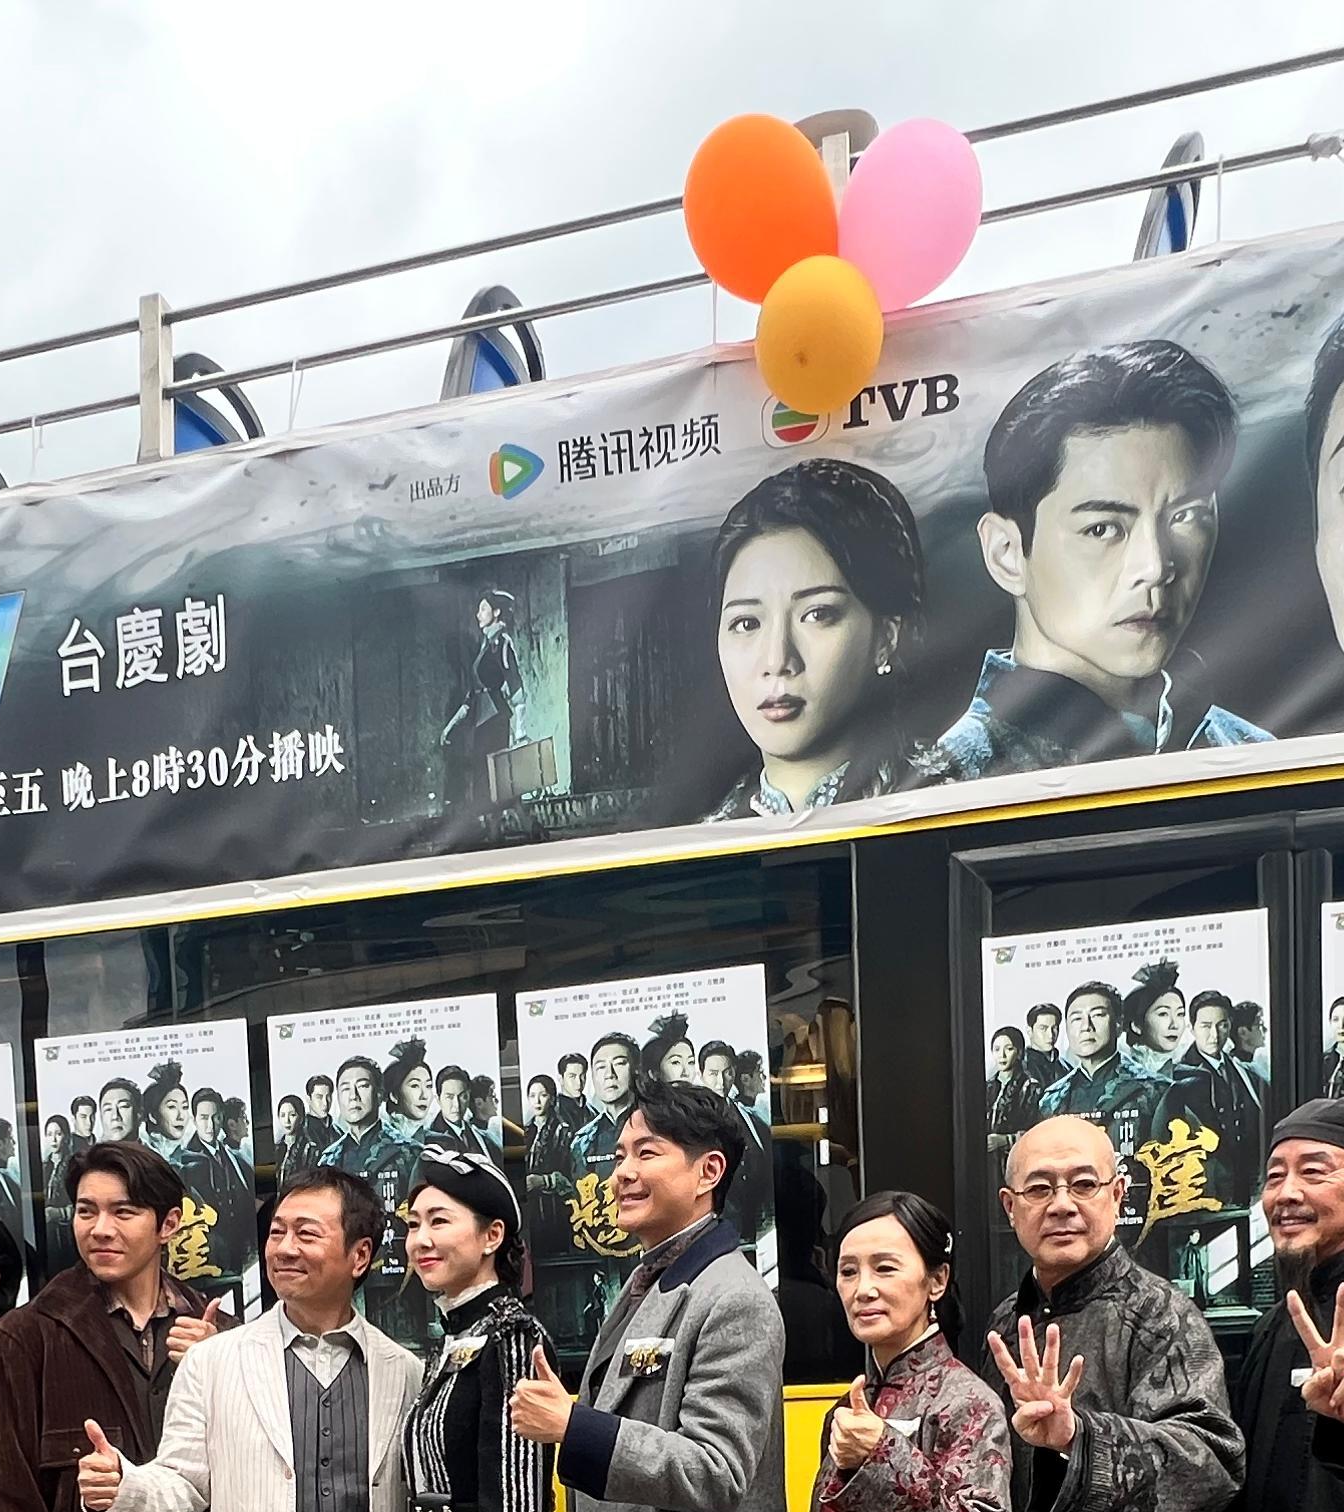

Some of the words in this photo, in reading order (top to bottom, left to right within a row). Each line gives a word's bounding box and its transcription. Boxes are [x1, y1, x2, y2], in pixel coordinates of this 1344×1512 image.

[843, 374, 960, 430] TVB
[558, 413, 720, 484] 腾讯视频
[409, 473, 461, 503] 出品方
[57, 593, 227, 697] 台慶劇
[61, 723, 345, 813] 晚上8時30分播映
